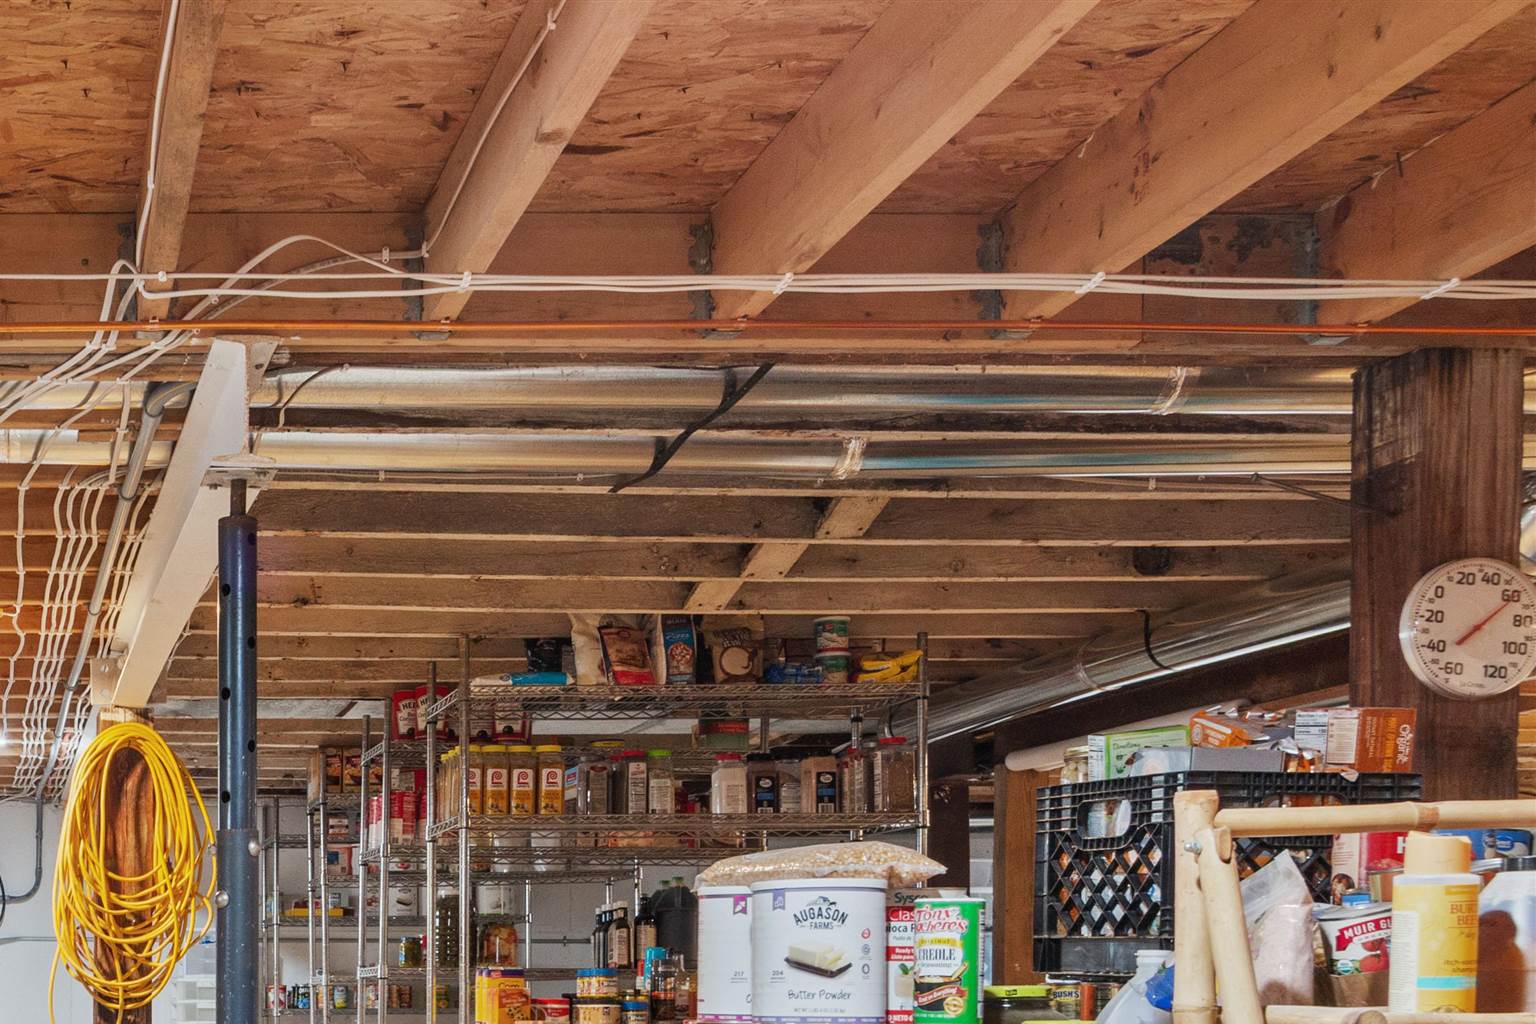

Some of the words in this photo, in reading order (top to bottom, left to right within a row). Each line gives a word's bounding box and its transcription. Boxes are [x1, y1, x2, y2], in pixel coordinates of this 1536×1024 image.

[1456, 572, 1476, 585] 20
[1481, 572, 1501, 585] 40
[1434, 586, 1444, 598] 0
[1501, 589, 1521, 603] 60
[1419, 609, 1444, 623] -20
[1513, 614, 1533, 628] 80
[1421, 640, 1446, 653] -40
[1502, 641, 1527, 655] 100
[1438, 662, 1464, 675] -60
[1483, 664, 1508, 679] 120
[793, 907, 848, 925] AUGASON
[809, 922, 834, 930] FARMS
[1344, 921, 1376, 939] MUIR
[788, 989, 814, 1000] Butter
[819, 989, 851, 1000] Powder
[1052, 990, 1080, 999] BUSH'S
